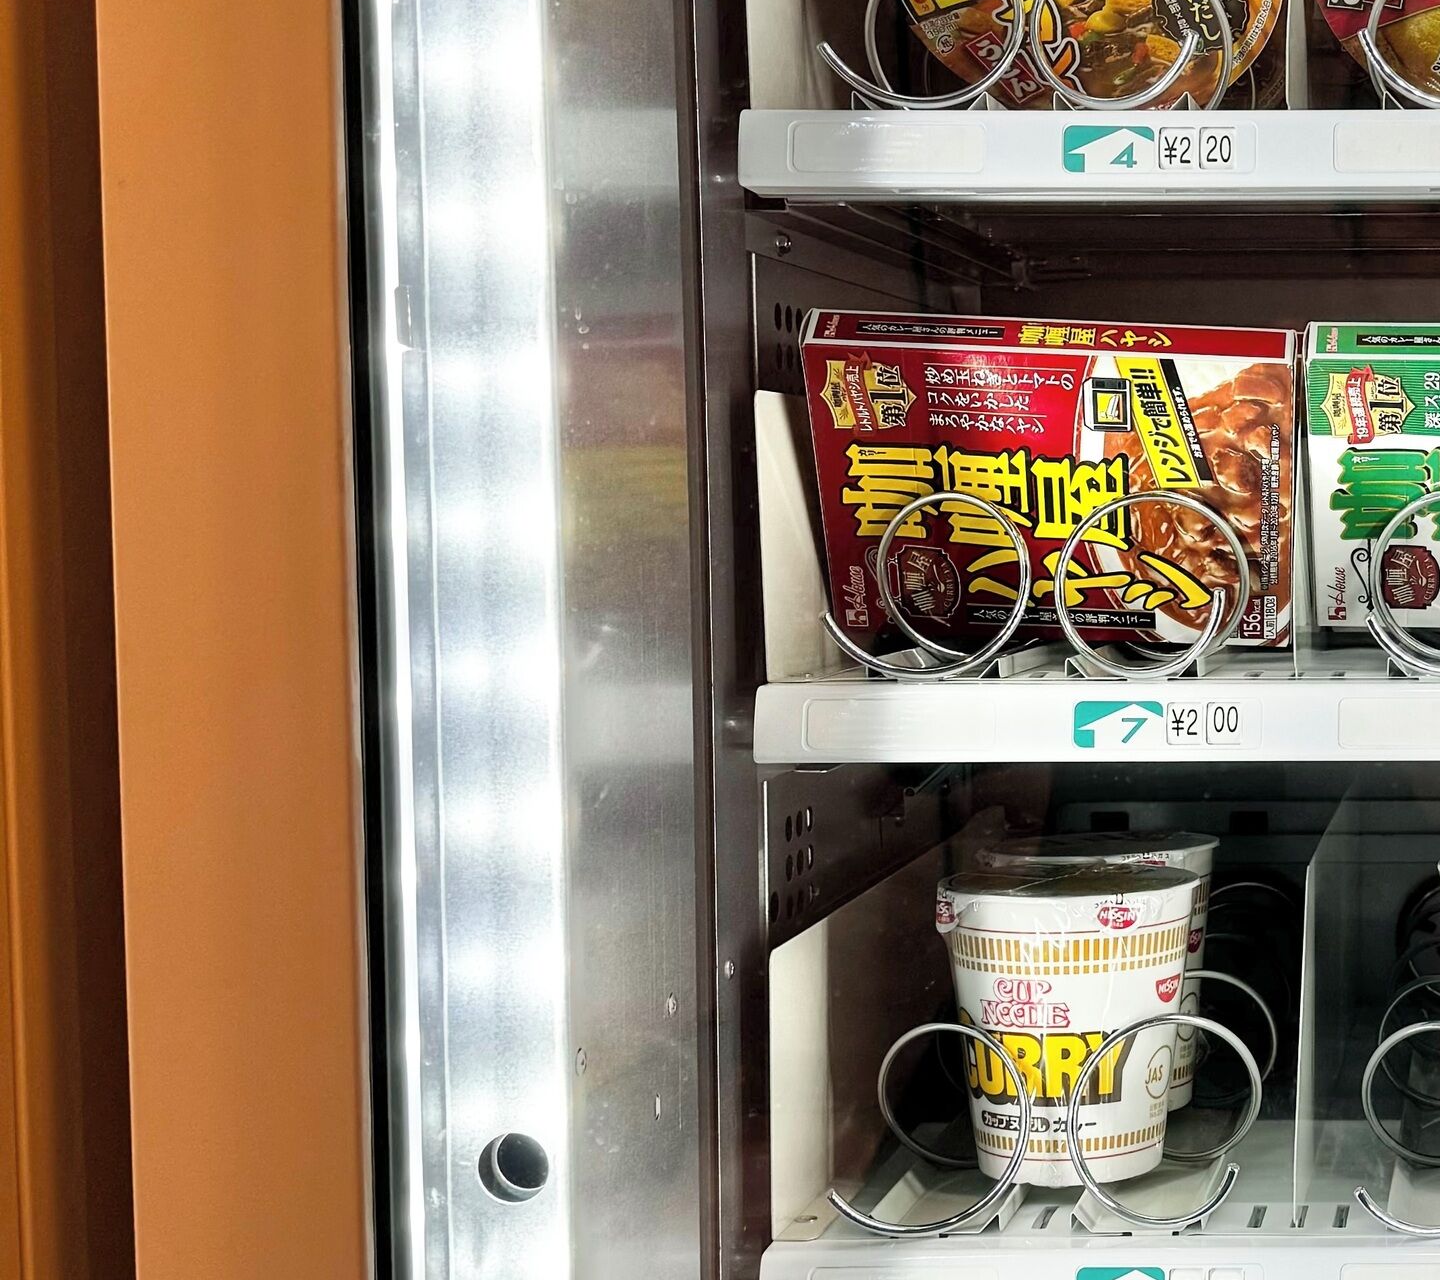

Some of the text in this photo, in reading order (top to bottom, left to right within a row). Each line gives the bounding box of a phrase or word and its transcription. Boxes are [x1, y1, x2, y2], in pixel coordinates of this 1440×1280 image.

[1109, 141, 1138, 169] 4
[925, 366, 1076, 392] 炒め玉ねぎとトマトの
[872, 365, 909, 427] 第1位
[927, 391, 1032, 408] コクをいかした
[1376, 373, 1405, 435] 第1位
[928, 414, 1046, 435] まろやかなハヤシ
[1128, 367, 1187, 487] レンジで簡単!!
[1120, 716, 1149, 745] 7
[992, 977, 1053, 1004] CUP
[1144, 1063, 1164, 1086] JAS
